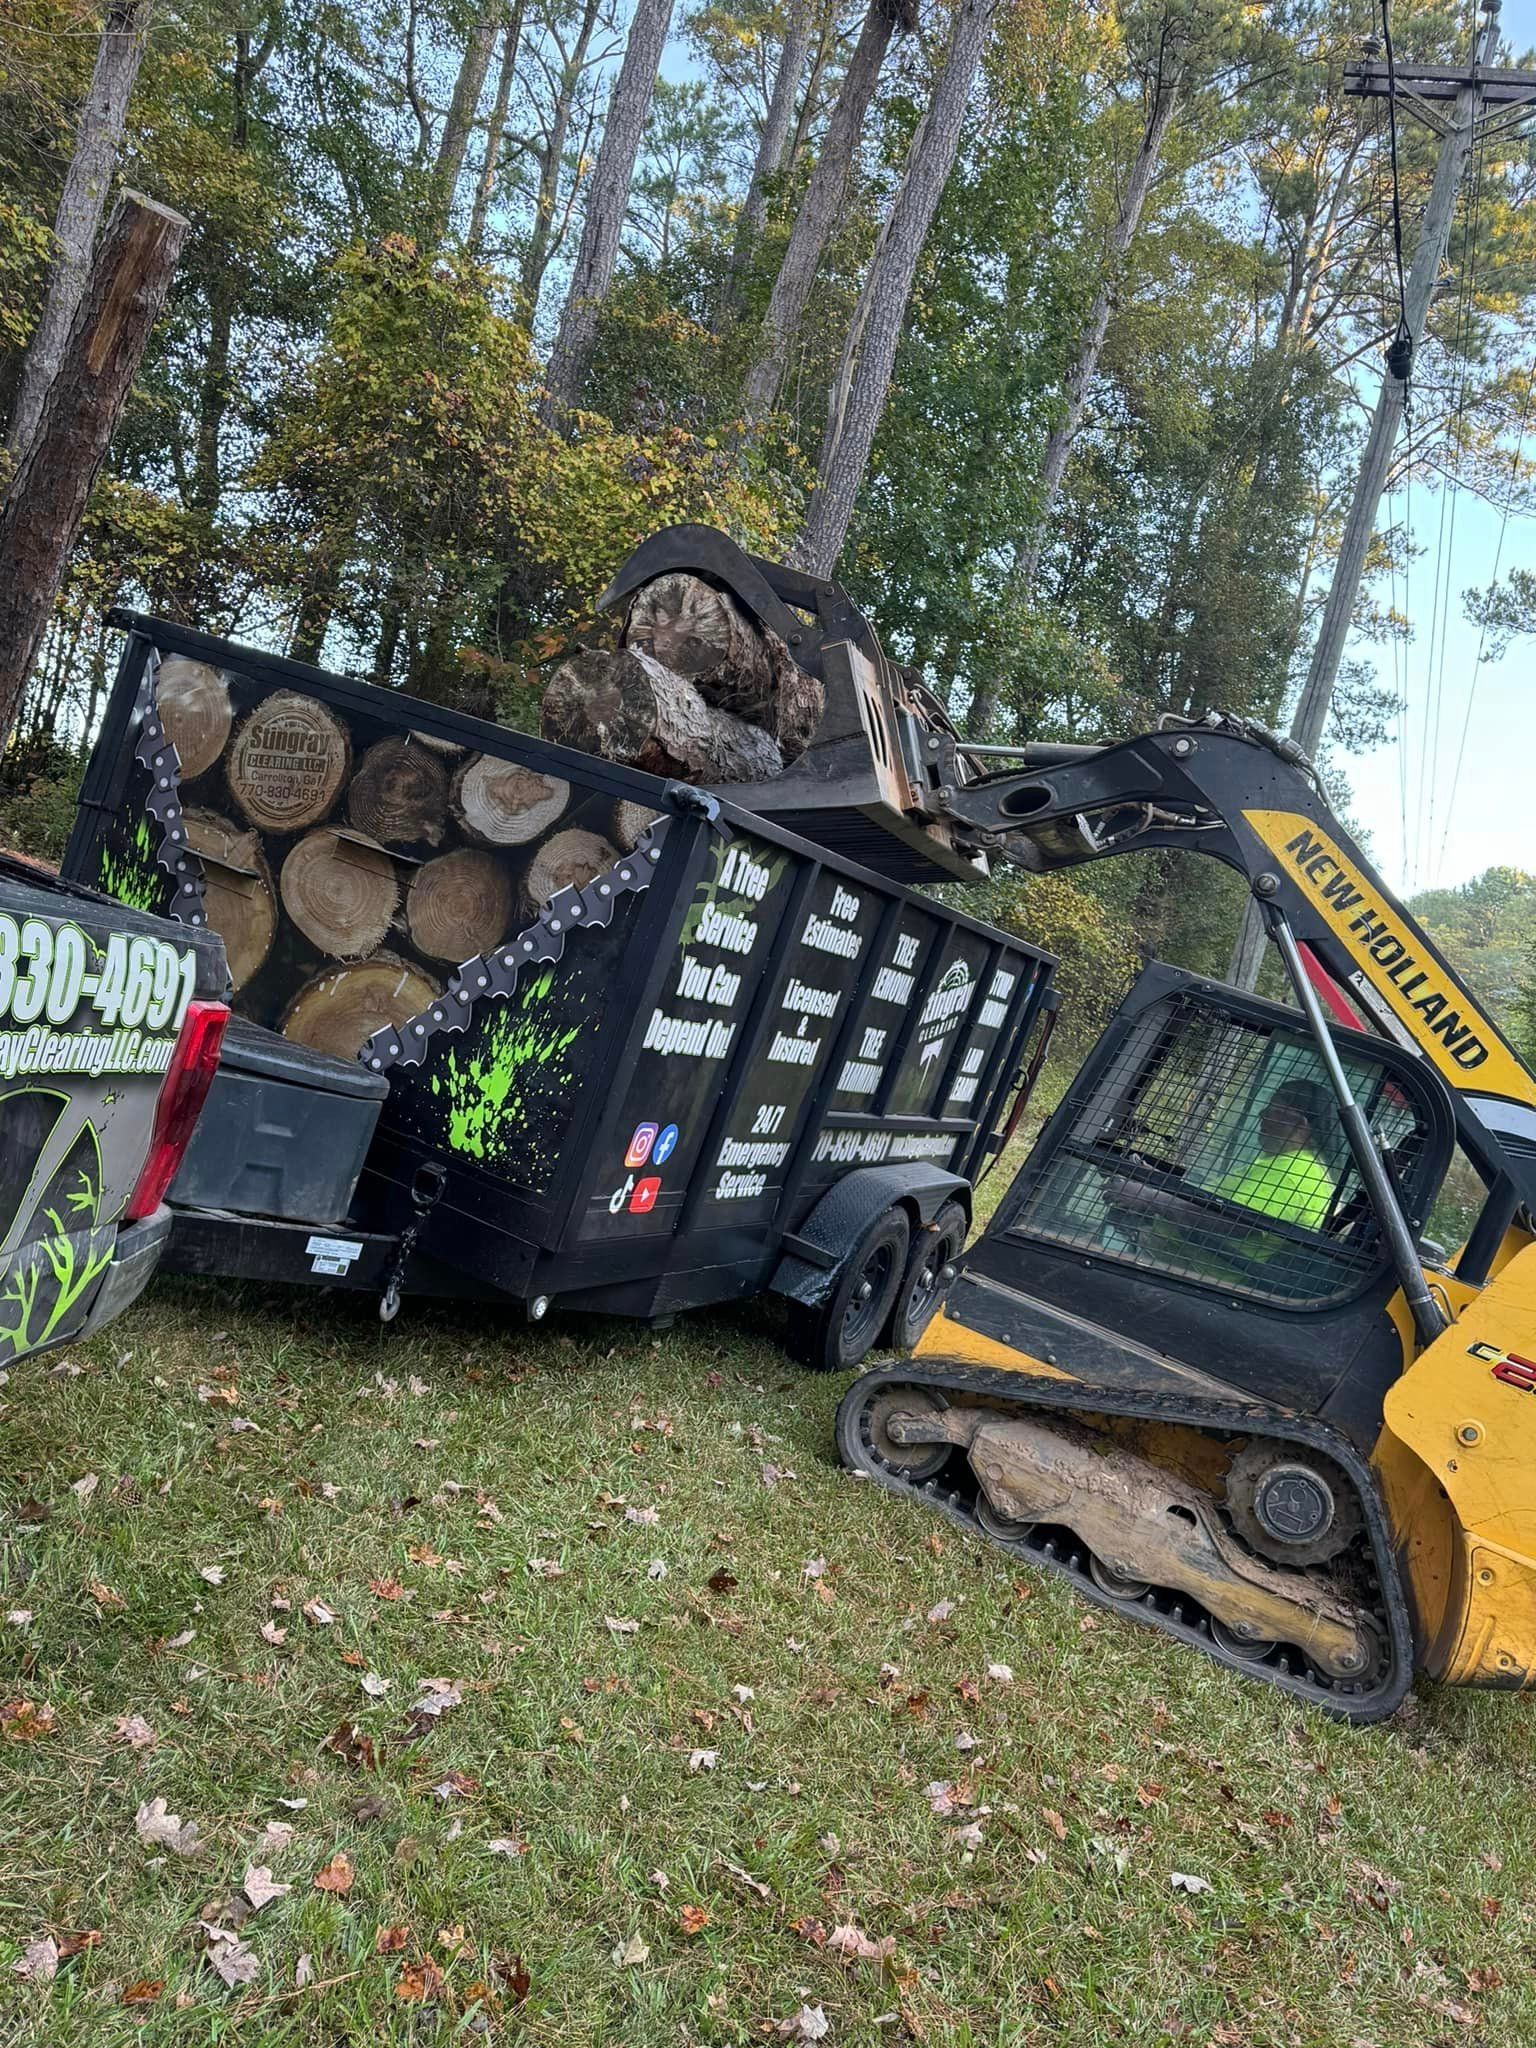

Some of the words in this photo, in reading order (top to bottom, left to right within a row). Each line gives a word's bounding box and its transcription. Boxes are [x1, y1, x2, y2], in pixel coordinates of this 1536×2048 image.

[250, 725, 330, 756] Stingray
[249, 754, 302, 770] CLEARING
[303, 758, 323, 773] LLC.
[240, 783, 326, 802] 770-830-4691
[718, 847, 738, 889] A
[731, 851, 770, 901] Tree
[829, 883, 860, 922] Free
[695, 901, 758, 955] Service
[800, 913, 863, 961] Estimates
[892, 932, 920, 970] TREE
[1286, 829, 1364, 913] NEW
[1348, 908, 1489, 1070] HOLLAND
[675, 955, 713, 1001] You
[706, 963, 741, 1007] Can
[781, 977, 842, 1018] Licensed
[642, 1007, 713, 1056] Depend
[704, 1019, 737, 1059] On!
[796, 1015, 809, 1037] &
[858, 1026, 887, 1060] TREE
[767, 1031, 821, 1066] Insured
[751, 1104, 786, 1134] 24/7
[716, 1137, 792, 1169] Emergency
[715, 1169, 767, 1200] Service
